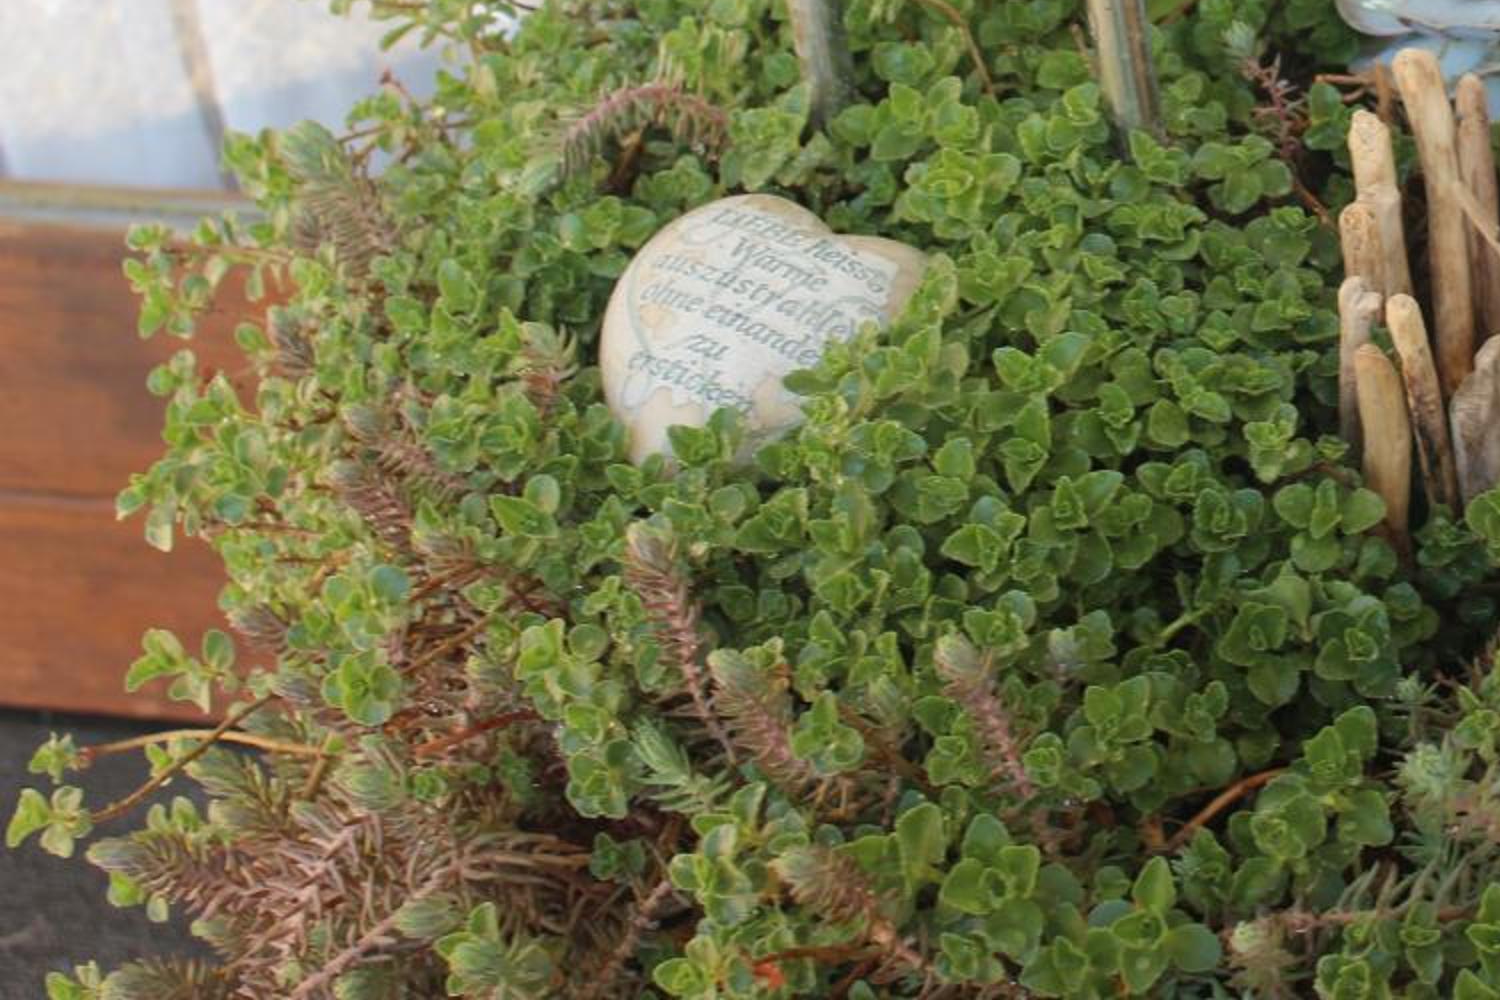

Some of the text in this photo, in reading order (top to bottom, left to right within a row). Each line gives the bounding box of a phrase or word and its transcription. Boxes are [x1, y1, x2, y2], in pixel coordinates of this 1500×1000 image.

[640, 281, 820, 366] ohne einande
[687, 332, 730, 362] zu
